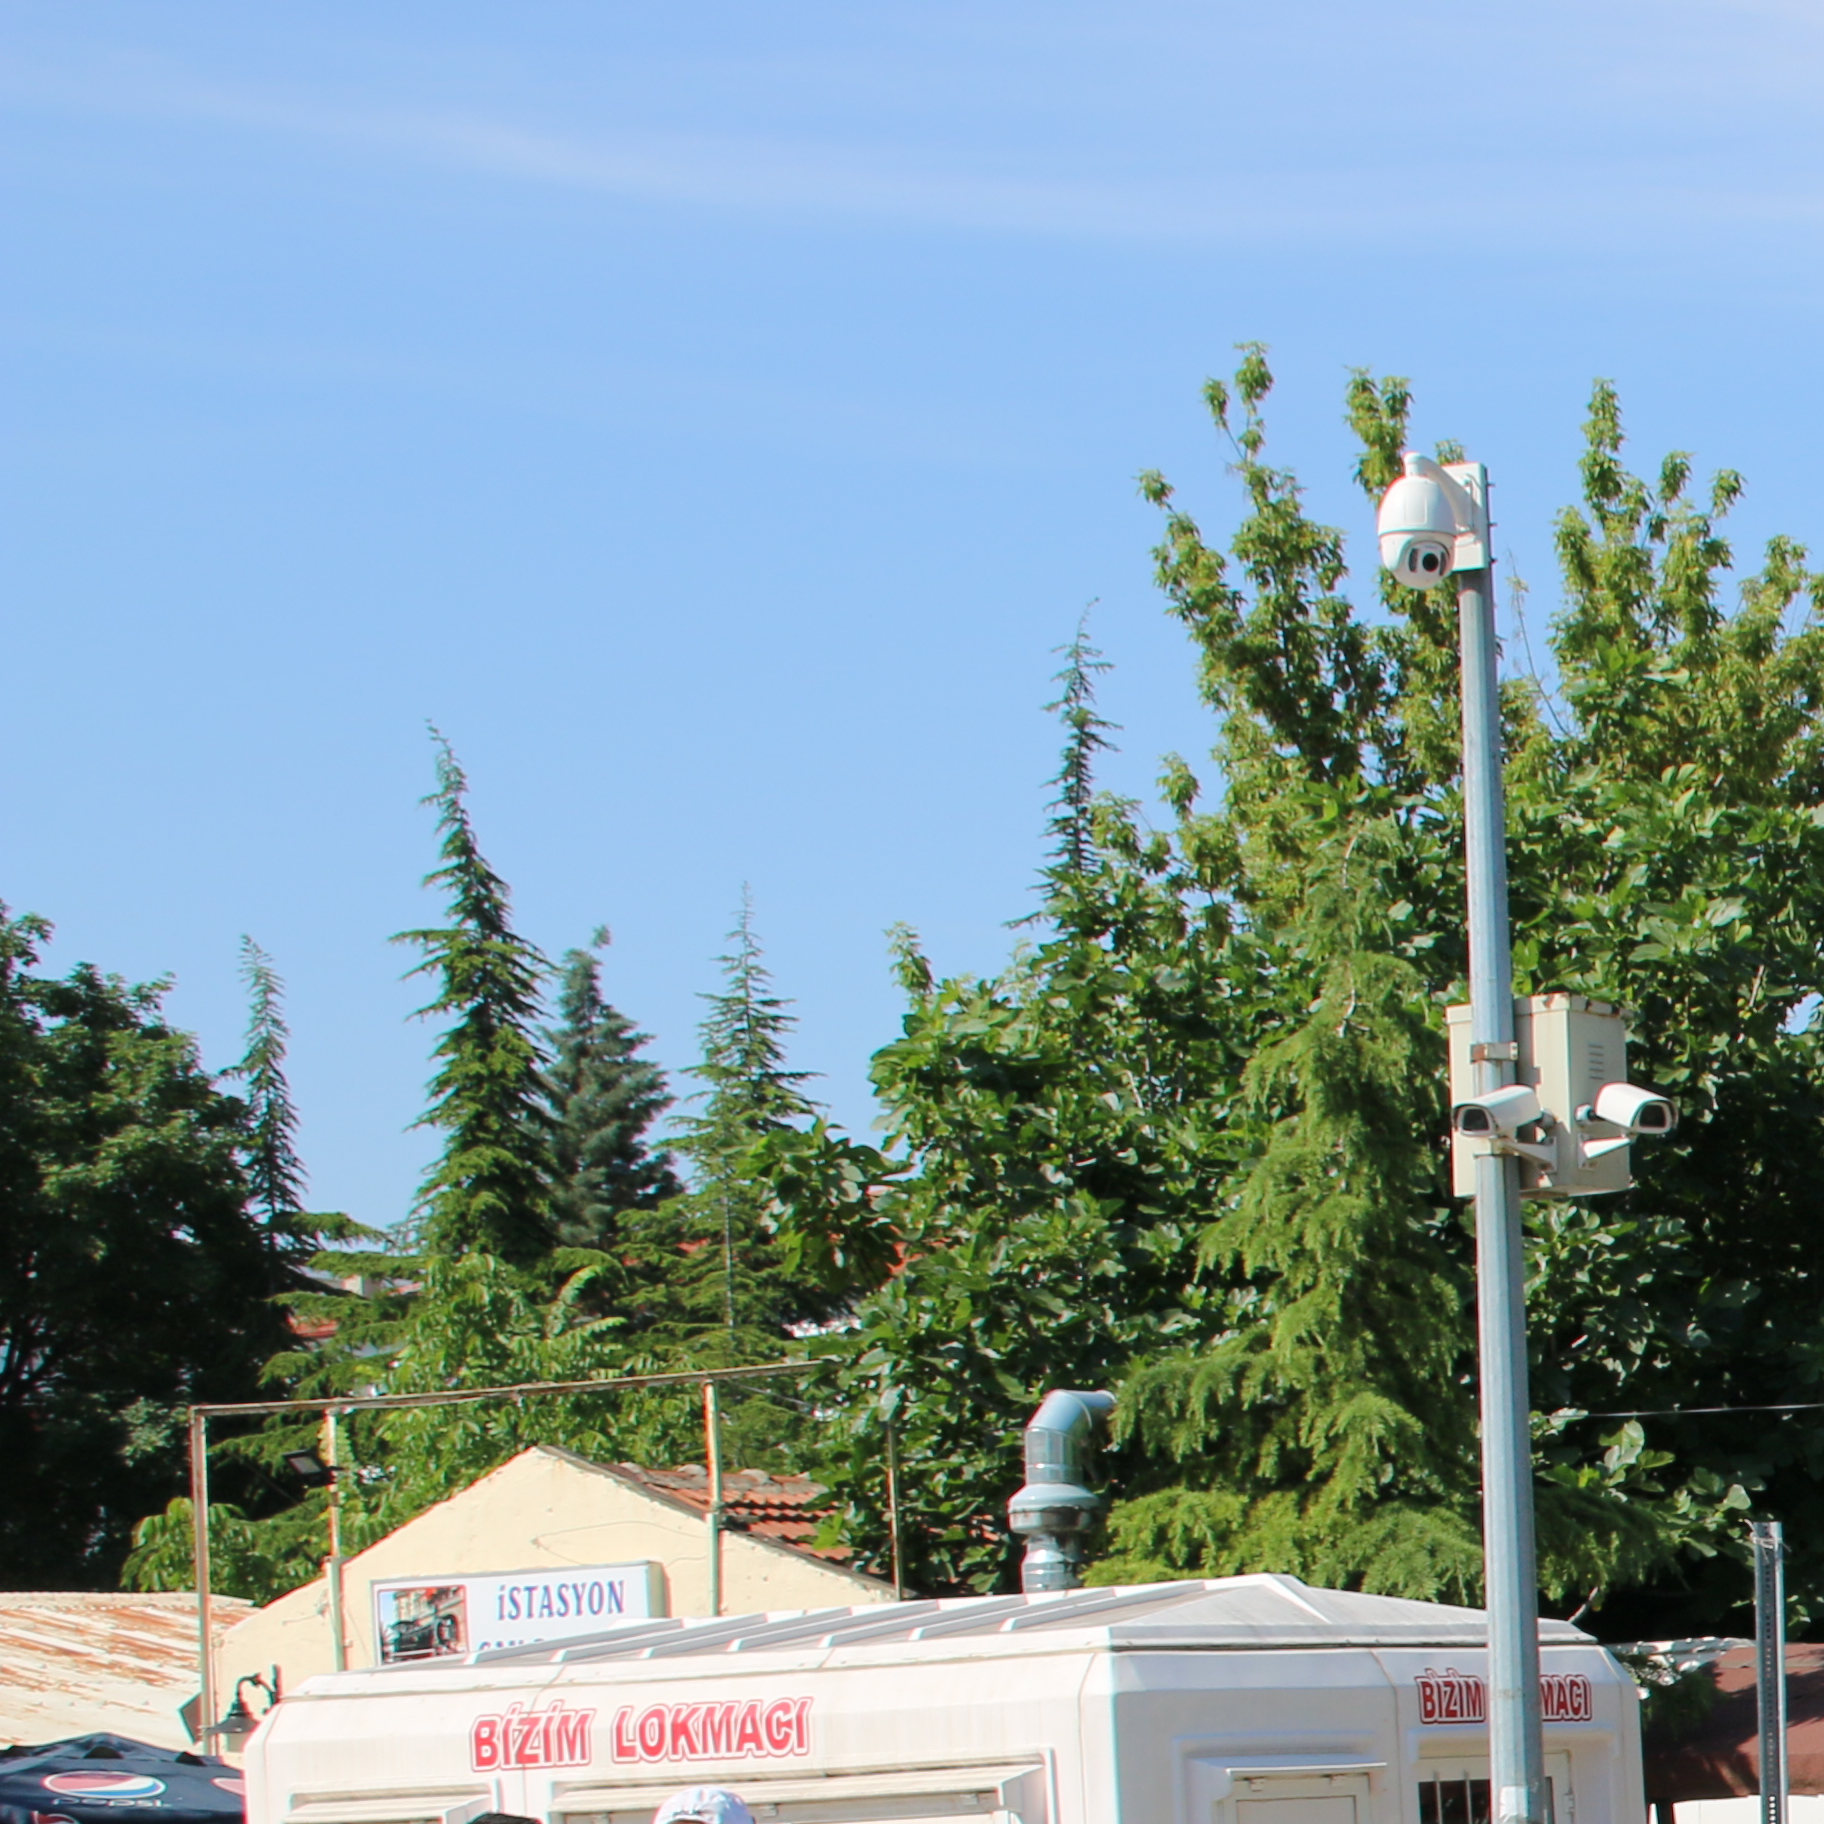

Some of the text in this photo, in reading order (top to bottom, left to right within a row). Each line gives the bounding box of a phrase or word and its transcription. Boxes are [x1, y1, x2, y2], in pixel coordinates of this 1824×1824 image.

[1414, 1668, 1593, 1724] BİZİM MACI
[470, 1696, 814, 1773] BİZİM LOKMACI
